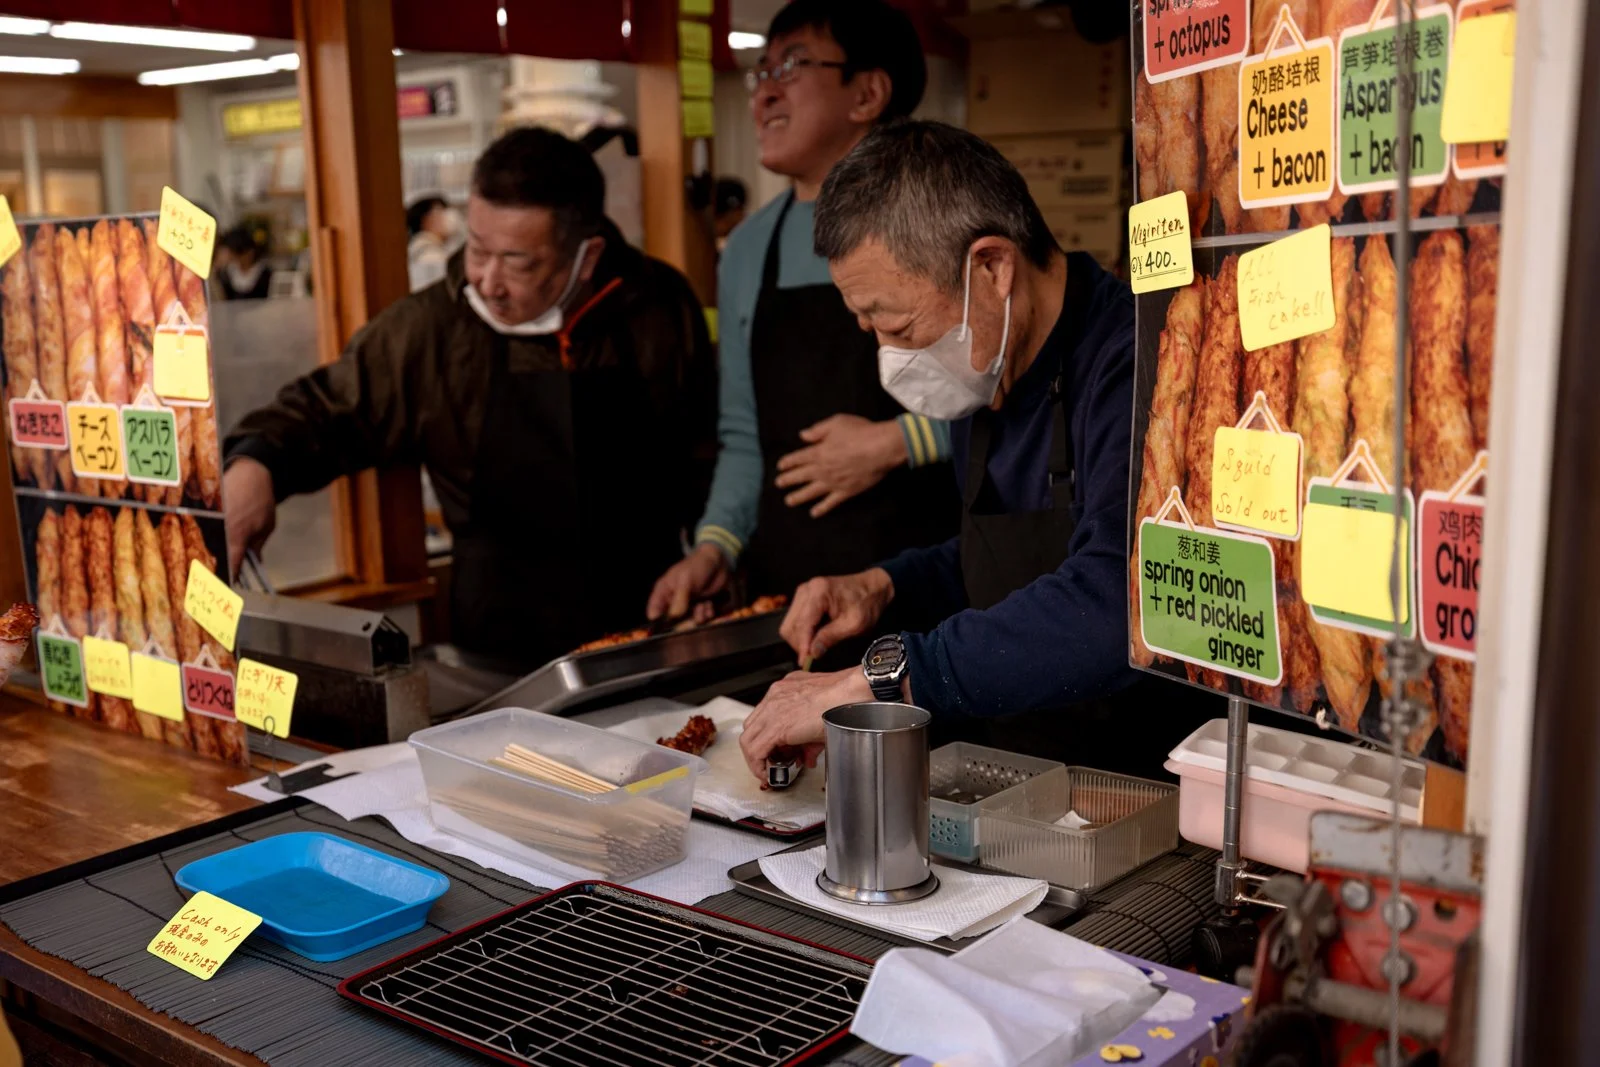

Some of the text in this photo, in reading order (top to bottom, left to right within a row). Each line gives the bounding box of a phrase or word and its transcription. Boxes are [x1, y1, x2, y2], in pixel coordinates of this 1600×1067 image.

[1154, 14, 1231, 62] + octopus
[1252, 56, 1320, 96] 奶酪培根
[1343, 68, 1441, 122] Asparus
[1247, 97, 1308, 139] Cheese
[1253, 147, 1326, 189] + bacon
[1350, 133, 1362, 176] +
[1369, 130, 1424, 175] bacn
[1131, 217, 1184, 247] Nigiriten
[1216, 492, 1288, 523] Sold out
[1177, 534, 1221, 566] 葱和姜
[1144, 558, 1246, 602] spring onion
[1150, 586, 1265, 639] + red pickled
[1208, 632, 1265, 670] ginger
[181, 909, 242, 943] Cash only
